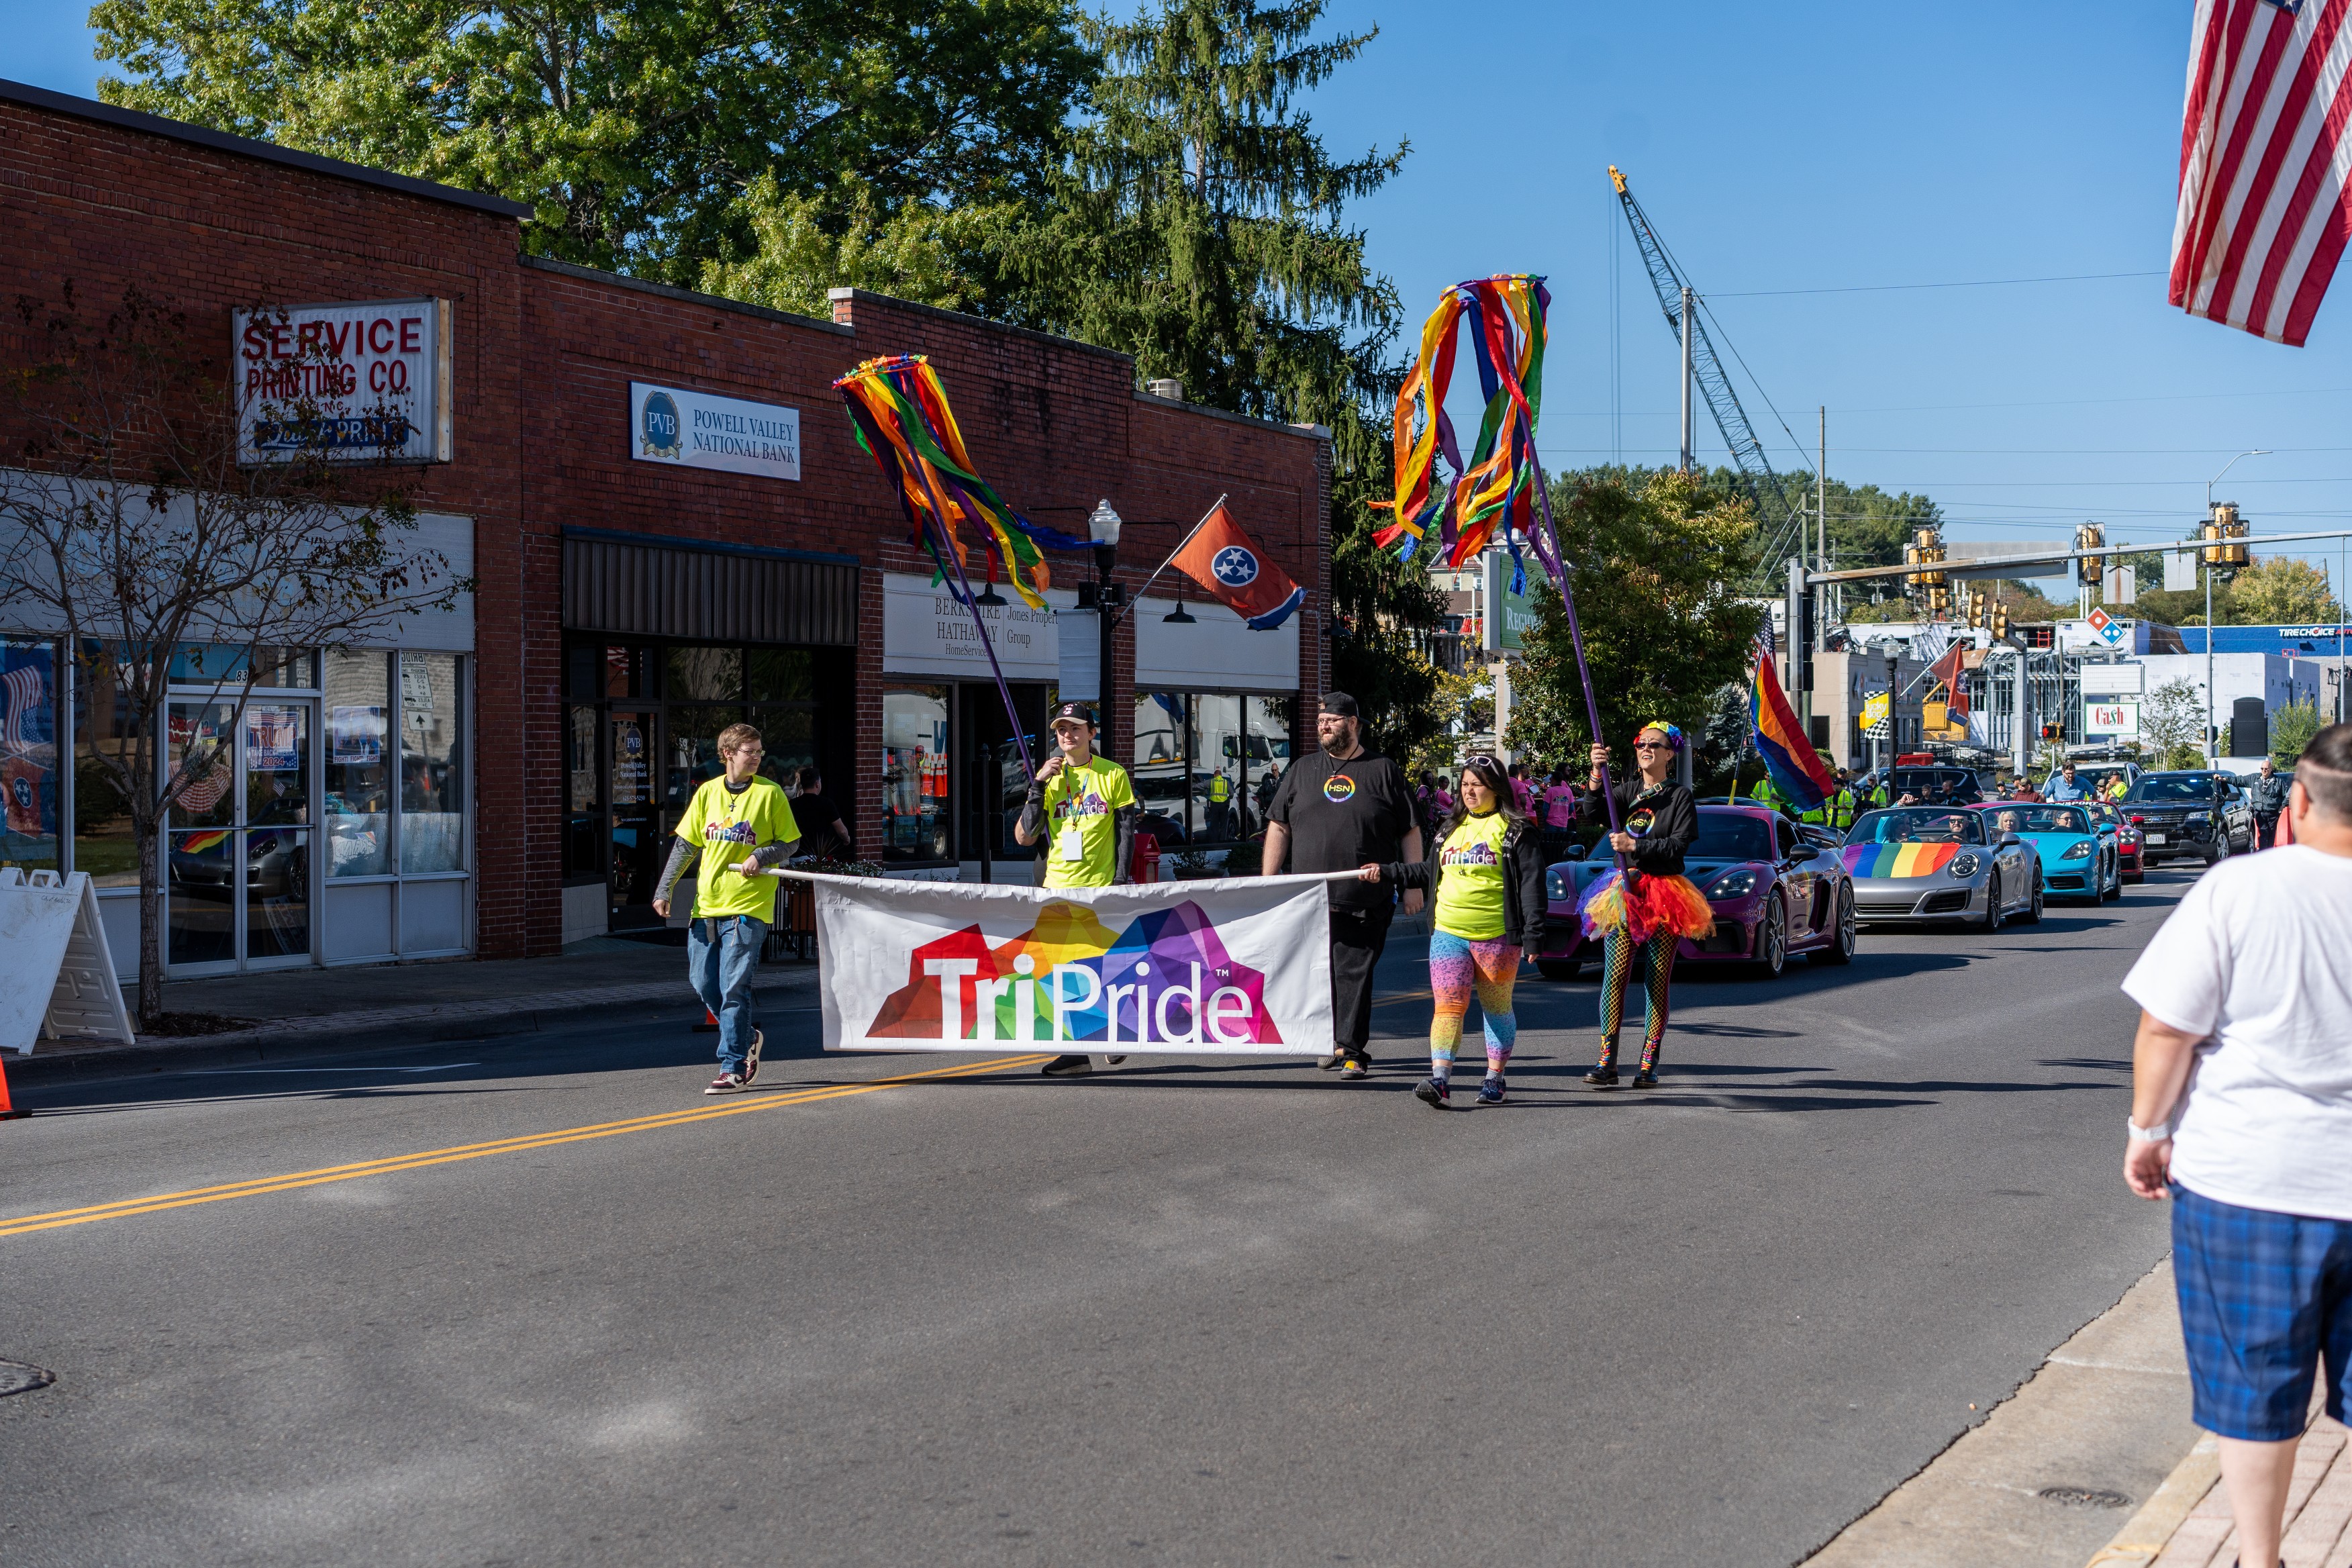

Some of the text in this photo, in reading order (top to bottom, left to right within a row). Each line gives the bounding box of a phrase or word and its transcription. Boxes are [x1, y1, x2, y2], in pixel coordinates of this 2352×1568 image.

[242, 317, 422, 360] SERVICE
[247, 359, 411, 399] PRINTING CO.
[336, 418, 403, 443] PRI
[648, 411, 675, 435] PVB
[693, 409, 794, 442] POWELL VALLEY
[693, 432, 760, 458] NATIONAL
[762, 442, 795, 464] BANK
[935, 597, 1058, 627] BERKSIRE Jones Propert
[1007, 629, 1030, 648] Group
[236, 671, 248, 681] 83
[1865, 701, 1888, 714] lucky
[250, 726, 296, 748] TRUMP
[627, 737, 641, 748] PVB
[263, 757, 285, 766] 2024
[634, 762, 646, 770] Valley
[1328, 784, 1351, 792] HSN
[1058, 801, 1106, 818] Trride
[1629, 818, 1651, 826] HSN
[708, 826, 754, 845] TriPride
[1444, 850, 1493, 865] TriPride
[924, 953, 1253, 1044] TriPride
